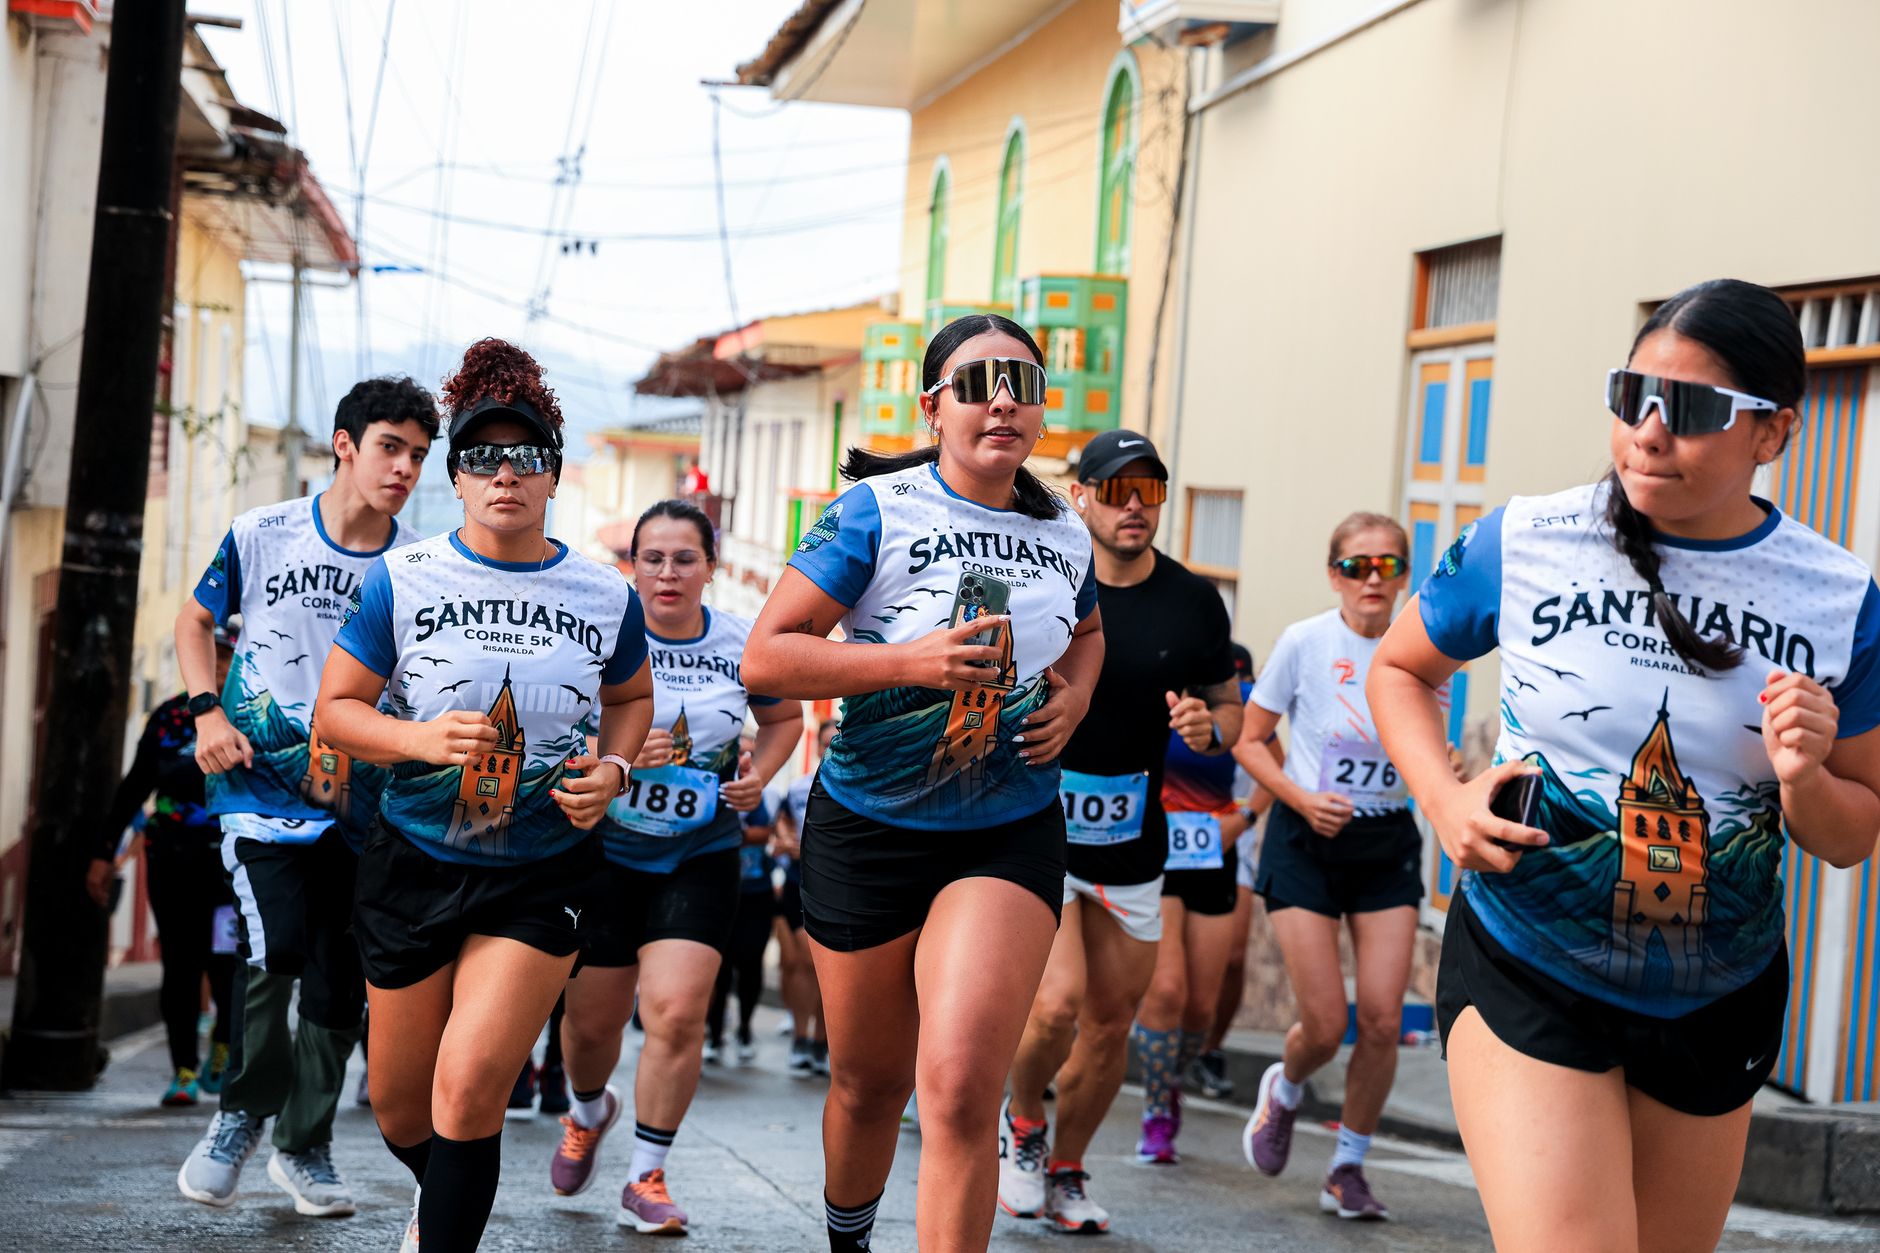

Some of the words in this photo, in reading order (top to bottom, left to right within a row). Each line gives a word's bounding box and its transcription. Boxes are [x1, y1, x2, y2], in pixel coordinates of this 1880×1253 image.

[258, 515, 286, 528] 2FIT
[1531, 513, 1580, 528] 2FIT
[908, 531, 1079, 591] SANTUARIO
[962, 560, 1017, 578] CORRE
[1021, 569, 1044, 580] 5K
[266, 564, 355, 607] SANTU
[415, 599, 603, 657] SANTUARIO
[464, 628, 525, 645] CORRE
[530, 635, 554, 647] 5K
[482, 644, 535, 656] RISARALDA
[1604, 630, 1677, 656] CORR
[654, 671, 694, 685] CORRE
[698, 674, 714, 684] 5K
[1336, 757, 1397, 788] 276
[628, 779, 698, 819] 188
[1064, 791, 1129, 823] 103
